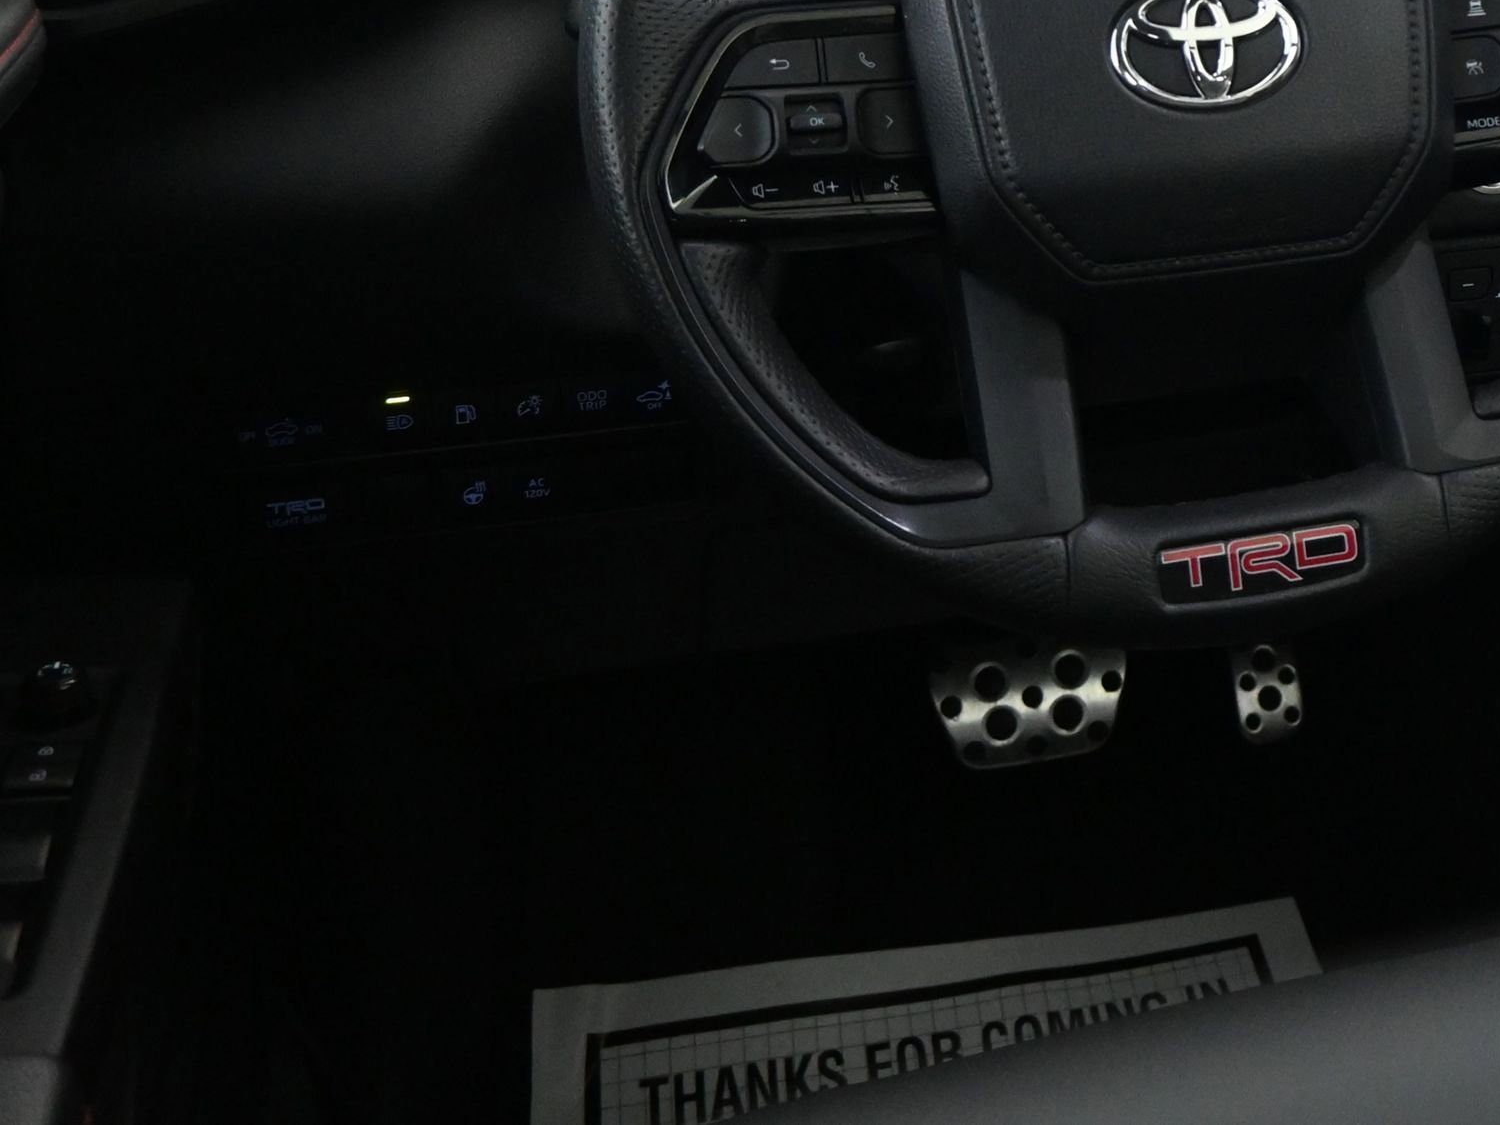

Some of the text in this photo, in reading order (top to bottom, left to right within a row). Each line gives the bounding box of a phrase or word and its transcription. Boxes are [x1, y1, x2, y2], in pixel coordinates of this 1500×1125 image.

[809, 117, 825, 126] OK
[1467, 116, 1500, 129] MODE
[577, 389, 607, 401] ODO
[578, 400, 607, 411] TRIP
[528, 477, 545, 487] AC
[524, 488, 551, 498] 120V
[265, 497, 325, 514] TRD
[1161, 524, 1358, 591] TRD
[639, 1050, 848, 1125] THANKS
[866, 1031, 963, 1081] FOR
